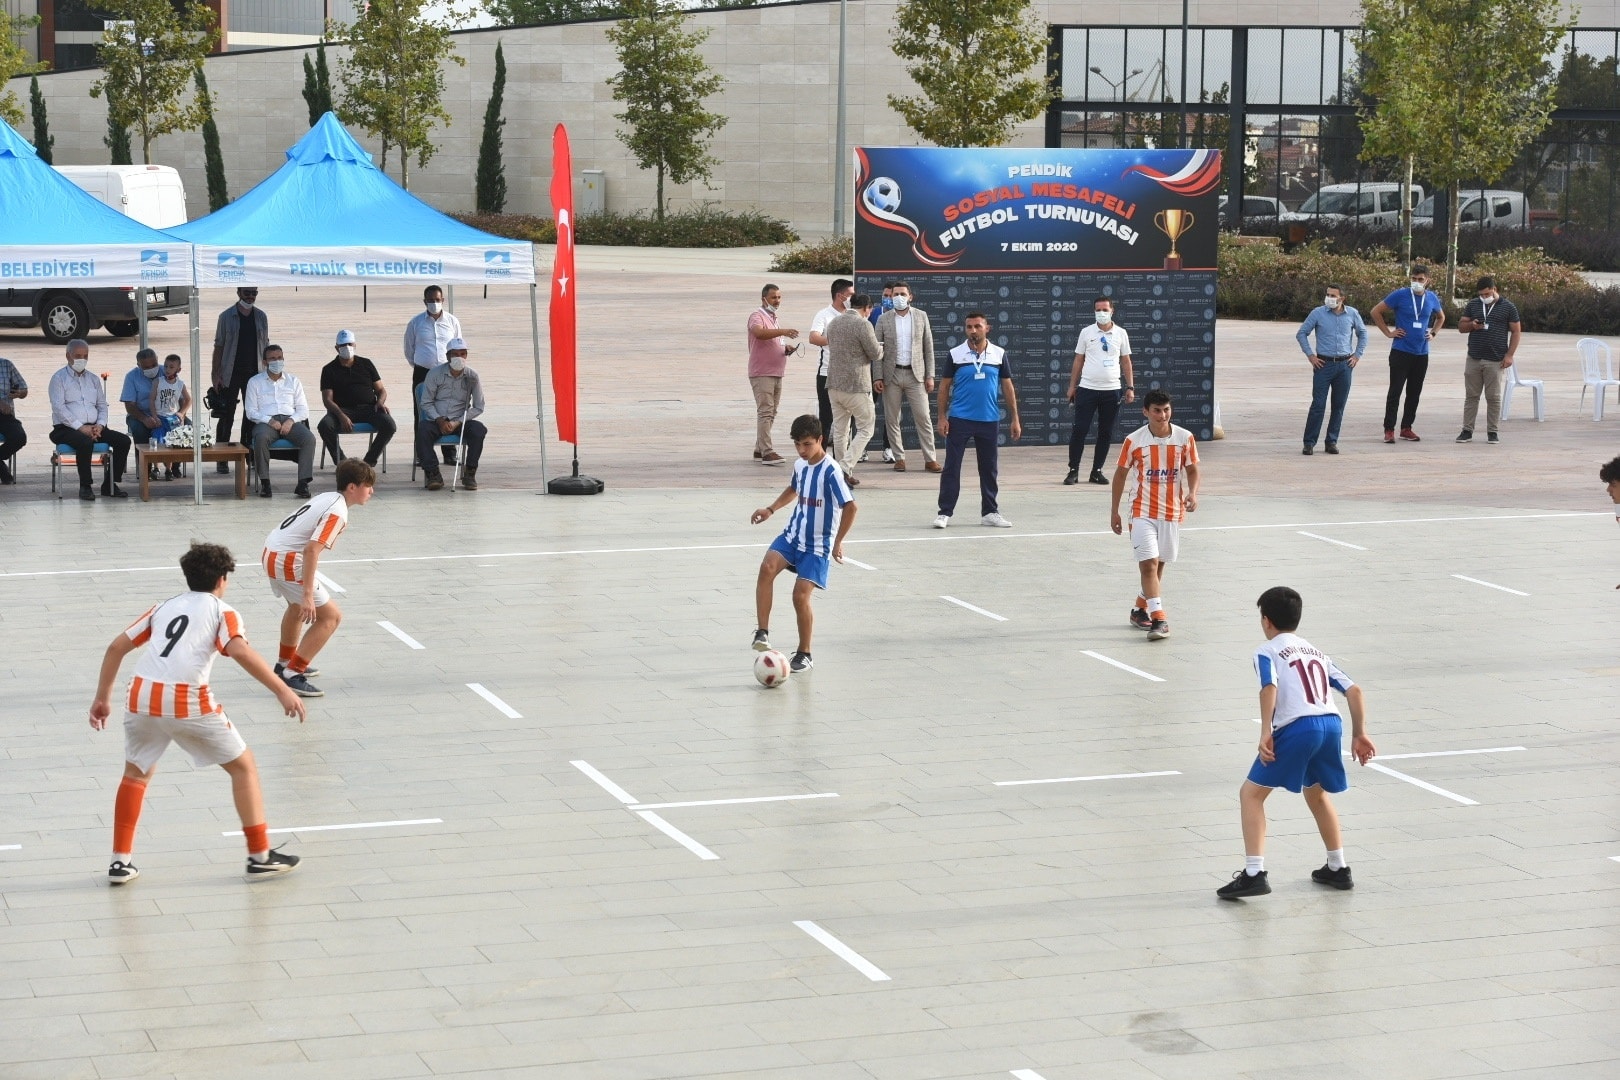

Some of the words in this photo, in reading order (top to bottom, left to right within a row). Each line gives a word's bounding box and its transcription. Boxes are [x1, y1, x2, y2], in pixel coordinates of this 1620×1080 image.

[1007, 162, 1073, 178] PENDİK
[943, 184, 1025, 222] SOSYAL
[1031, 182, 1137, 220] MESAFELİ
[938, 207, 1019, 248] FUTBOL
[1024, 204, 1139, 246] TURNUVASI
[1001, 242, 1009, 251] 7
[1046, 242, 1078, 251] 2020
[1, 258, 95, 278] BELEDİYESİ
[289, 260, 348, 276] PENDİK
[356, 258, 443, 275] BELEDİYESİ
[279, 504, 312, 530] 8
[159, 614, 190, 658] 9
[1288, 658, 1328, 705] 10
